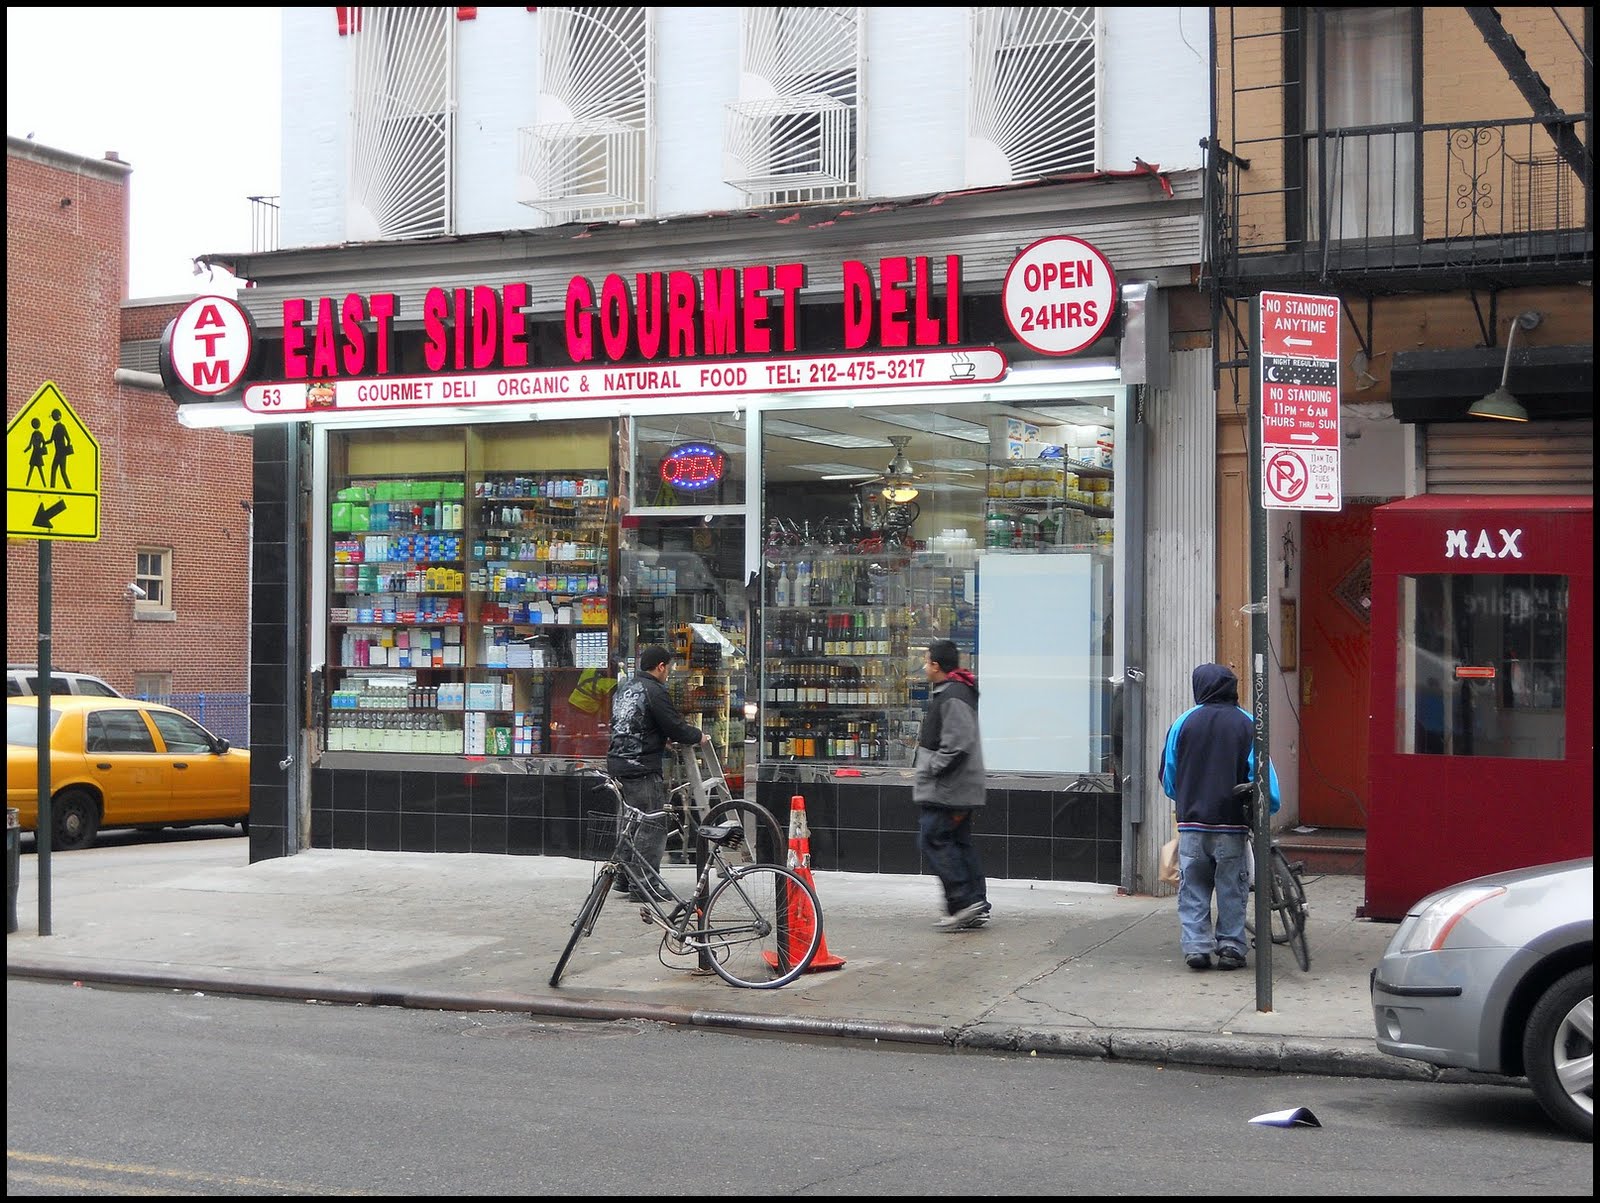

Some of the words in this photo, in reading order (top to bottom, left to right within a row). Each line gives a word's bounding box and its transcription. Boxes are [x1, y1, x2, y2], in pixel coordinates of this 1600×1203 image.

[1023, 259, 1094, 293] OPEN
[283, 292, 398, 379] EAST
[423, 282, 530, 372] SIDE
[564, 263, 805, 363] GOURMET
[842, 254, 964, 350] DELI
[1020, 301, 1099, 332] 24HRS
[1266, 299, 1281, 313] NO
[1285, 300, 1334, 318] STANDING
[1274, 317, 1327, 334] ANYTIME
[192, 304, 230, 387] ATM
[1273, 358, 1291, 366] NIGHT
[1293, 360, 1330, 368] REGULATION
[357, 382, 434, 404] GOURMET
[442, 379, 477, 399] DELI
[497, 375, 569, 397] ORGANIC
[579, 374, 590, 393] &
[604, 370, 681, 393] NATURAL
[700, 367, 748, 387] FOOD
[766, 364, 801, 385] TEL:
[809, 357, 926, 384] 212-475-3217
[262, 388, 282, 407] 53
[1270, 387, 1284, 401] NO
[1287, 388, 1332, 403] STANDING
[1273, 402, 1297, 415] 11PM
[1265, 415, 1295, 428] THURS
[1298, 420, 1315, 428] THRU
[1318, 419, 1337, 430] SUN
[661, 455, 723, 480] OPEN
[1445, 528, 1523, 559] MAX
